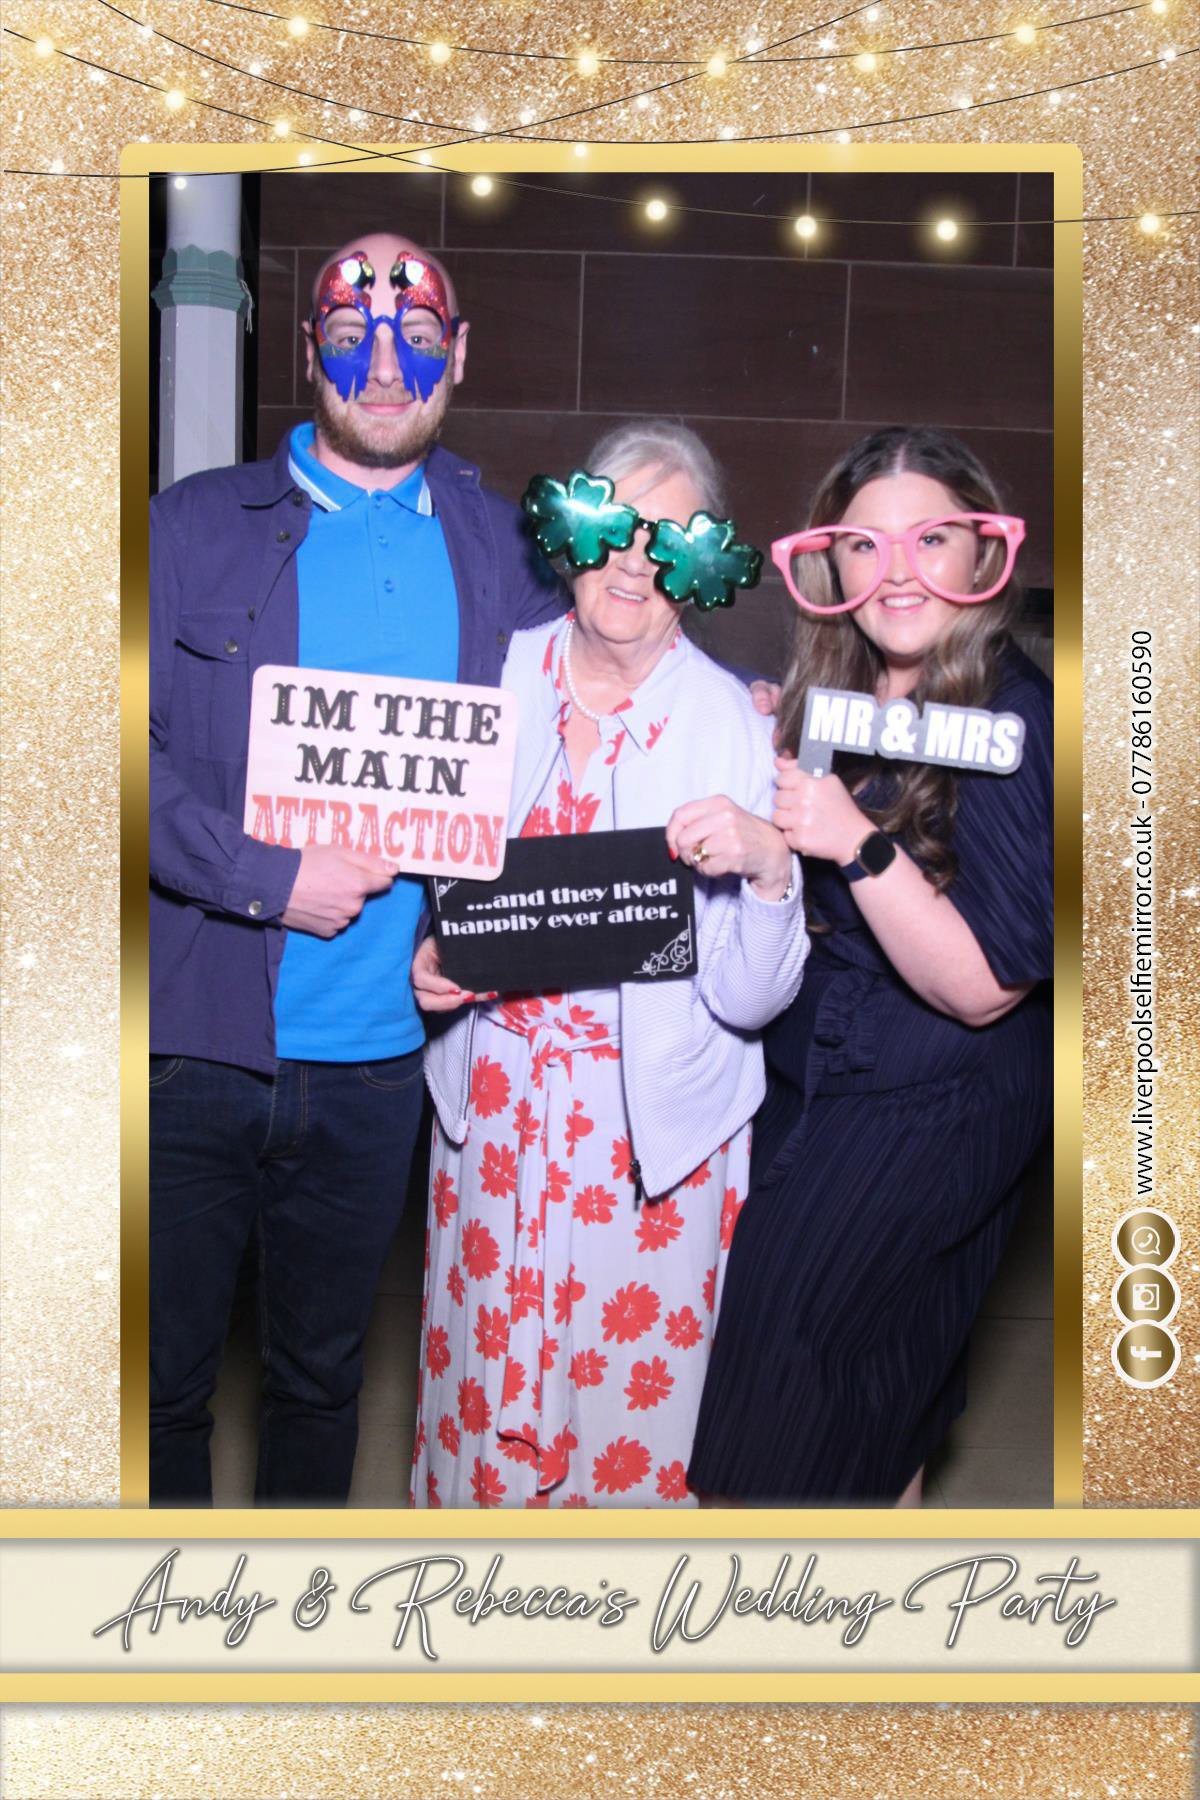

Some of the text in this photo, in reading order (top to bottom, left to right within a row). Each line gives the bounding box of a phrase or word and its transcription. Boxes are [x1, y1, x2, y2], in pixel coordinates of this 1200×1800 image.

[270, 683, 502, 746] IM THE
[808, 694, 1020, 768] MR & MRS
[294, 743, 470, 797] MAIN
[252, 794, 504, 868] ATTRACTION
[441, 903, 679, 936] happily ever after.
[466, 878, 678, 912] ...and they lived
